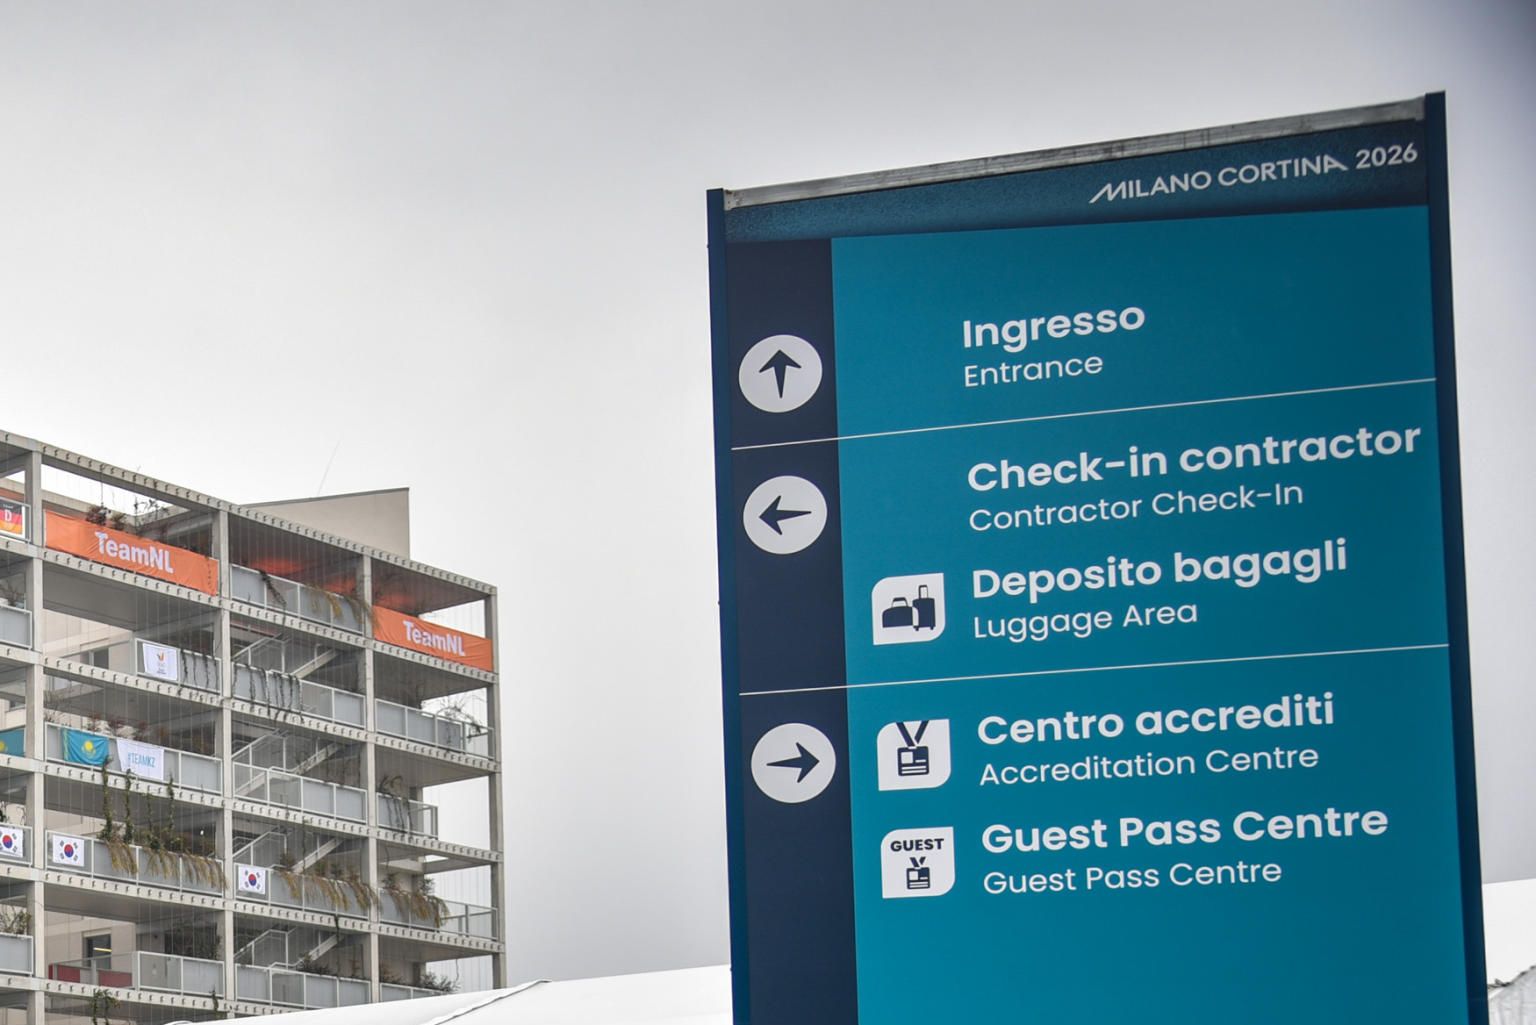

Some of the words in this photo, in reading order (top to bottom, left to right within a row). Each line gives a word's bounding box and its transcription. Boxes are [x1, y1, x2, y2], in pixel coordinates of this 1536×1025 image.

[1088, 170, 1212, 204] MILANO
[1217, 154, 1350, 188] CORTINA
[1355, 142, 1418, 170] 2026
[963, 306, 1146, 354] Ingresso
[964, 356, 1104, 388] Entrance
[967, 445, 1168, 493] Check-in
[1179, 427, 1422, 473] contractor
[969, 498, 1144, 532] Contractor
[1151, 483, 1304, 516] Check-In
[94, 531, 174, 574] TeamNL
[972, 555, 1163, 605] Deposito
[1173, 536, 1347, 588] bagagli
[402, 619, 466, 657] TeamNL
[974, 610, 1114, 644] Luggage
[1122, 604, 1199, 629] Area
[977, 711, 1125, 746] Centro
[1135, 691, 1335, 736] accrediti
[979, 752, 1197, 786] Accreditation
[1205, 746, 1320, 774] Centre
[890, 838, 944, 852] GUEST
[981, 819, 1109, 855] Guest
[1119, 817, 1222, 848] Pass
[1232, 807, 1389, 841] Centre
[983, 867, 1078, 896] Guest
[1086, 867, 1161, 891] Pass
[1169, 860, 1283, 887] Centre
